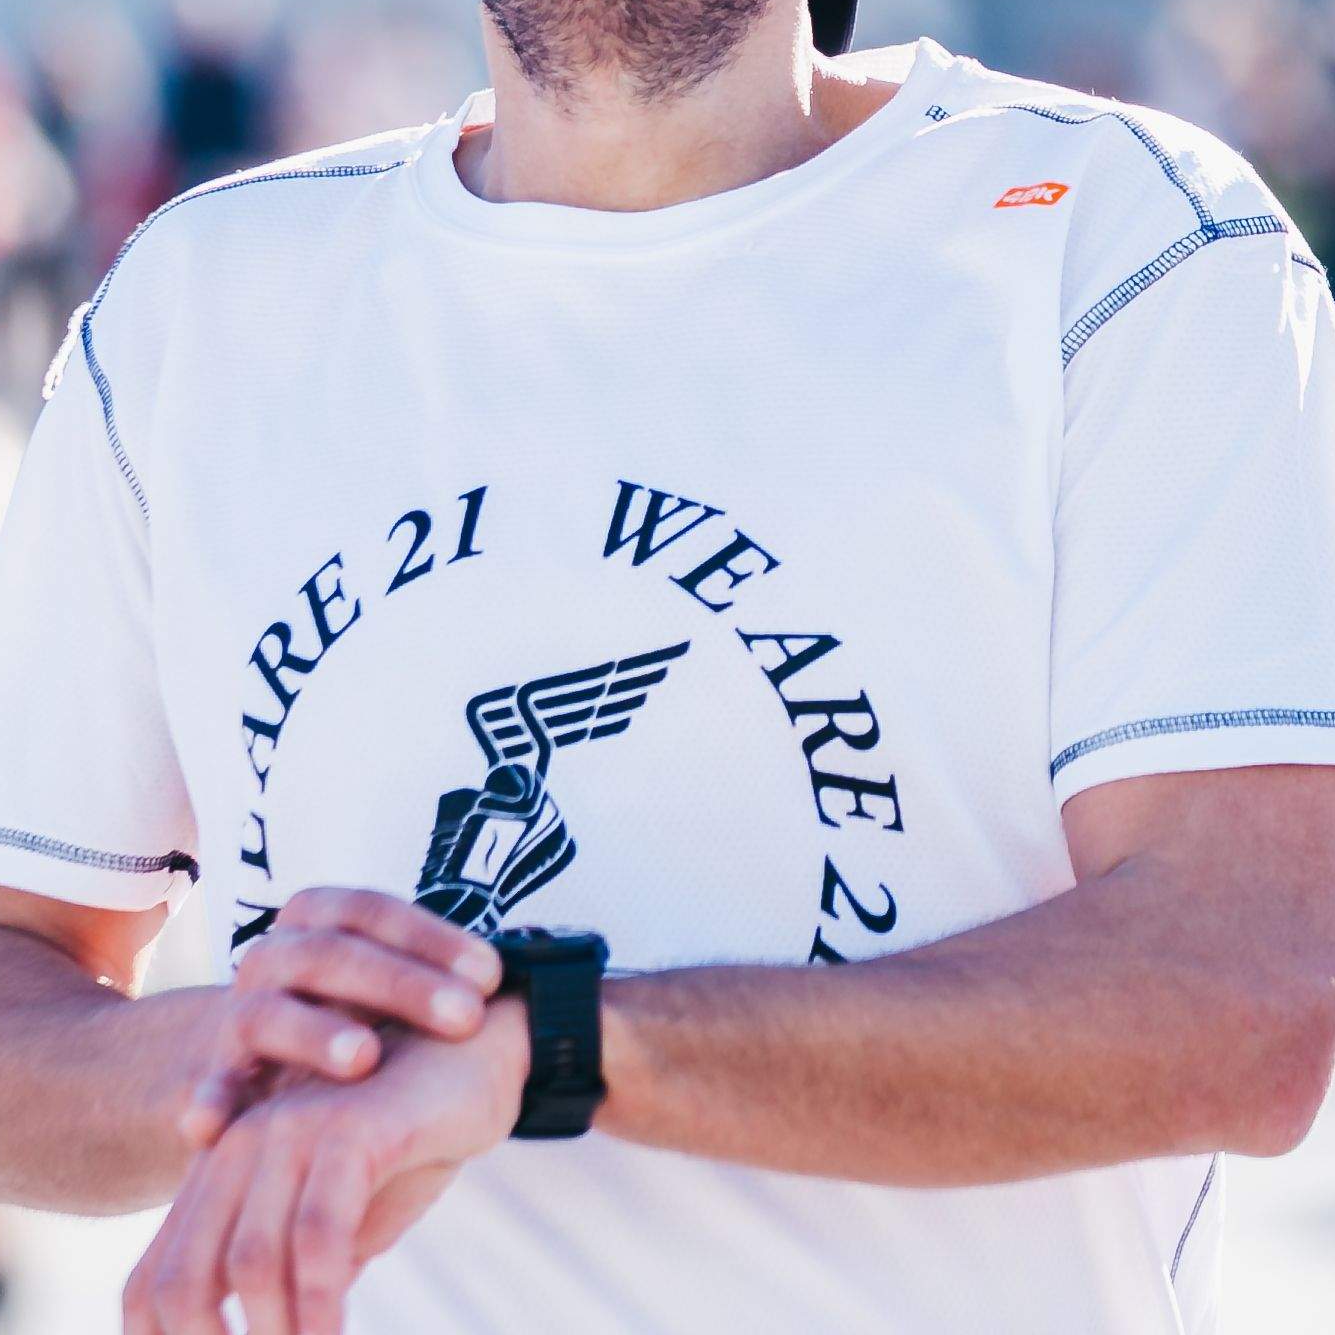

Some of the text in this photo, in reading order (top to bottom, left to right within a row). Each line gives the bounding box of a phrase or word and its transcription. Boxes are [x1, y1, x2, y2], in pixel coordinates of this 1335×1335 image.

[384, 484, 490, 597] 21
[602, 479, 782, 614] WE
[735, 627, 905, 834] ARE
